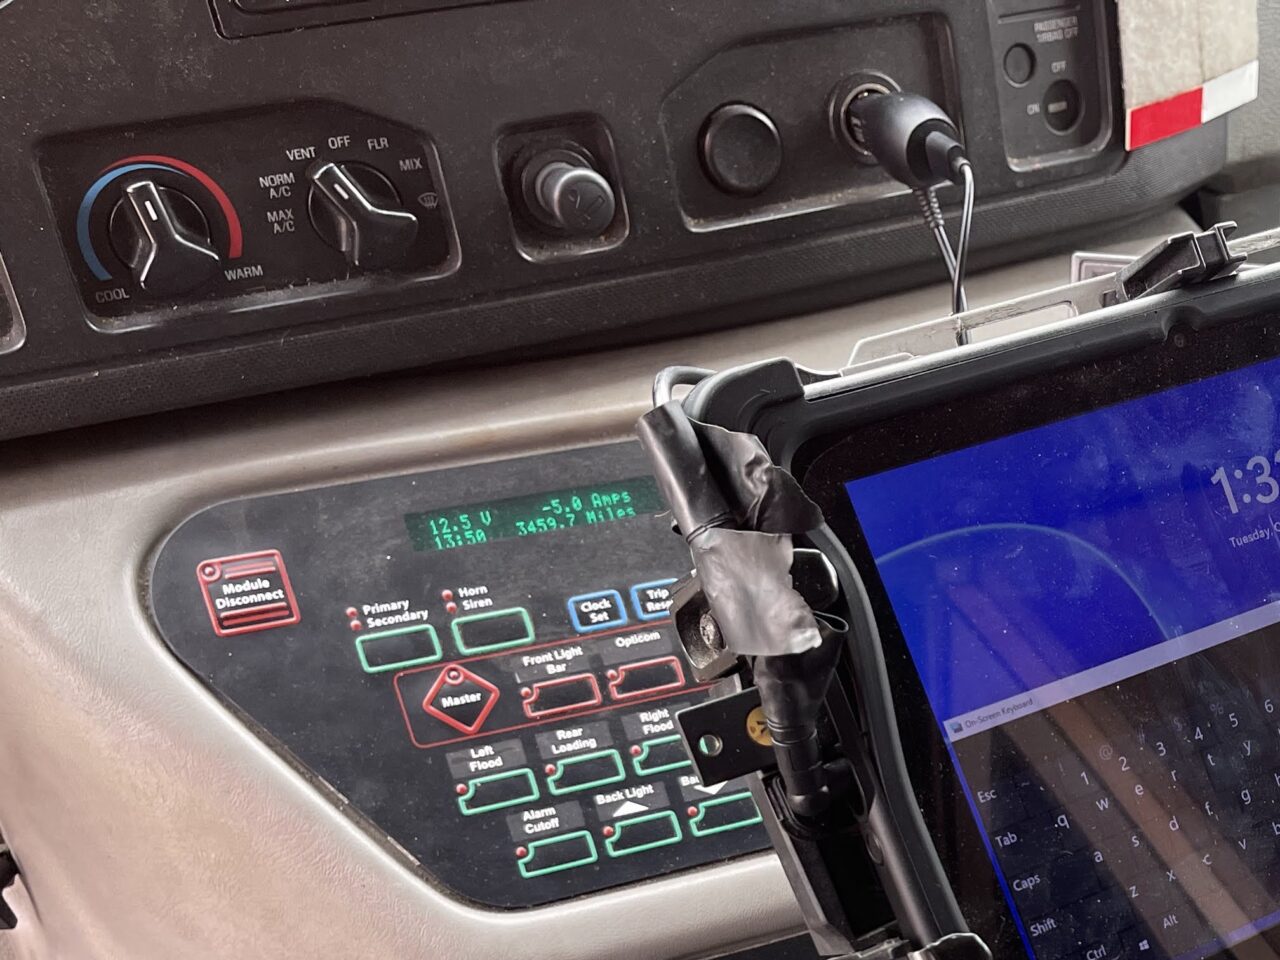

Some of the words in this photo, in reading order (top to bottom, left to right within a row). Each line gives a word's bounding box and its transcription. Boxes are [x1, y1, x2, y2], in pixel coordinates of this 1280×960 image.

[1051, 60, 1066, 73] OFF
[1026, 102, 1040, 115] ON
[327, 135, 350, 149] OFF
[367, 137, 389, 150] FLR
[286, 146, 317, 161] VENT
[399, 157, 423, 171] MIX
[259, 172, 295, 187] NORM
[269, 186, 291, 199] A/C
[267, 208, 294, 223] MAX
[273, 220, 295, 234] A/C
[224, 264, 264, 282] WARM
[95, 287, 130, 303] COOL
[429, 514, 472, 535] 12.5
[479, 510, 492, 527] V
[542, 496, 582, 514] -5.0
[591, 491, 632, 508] Amps
[434, 529, 487, 550] 13:50
[515, 513, 576, 536] 3459.7
[586, 505, 636, 525] Miles
[1228, 526, 1274, 548] Tuesday,
[222, 578, 270, 595] Module
[458, 585, 488, 598] Horn
[646, 587, 670, 600] Trip
[215, 589, 285, 609] Disconnect
[462, 598, 493, 610] Siren
[580, 598, 612, 613] Clock
[362, 600, 409, 616] Primary
[366, 609, 429, 628] Secondary
[589, 611, 609, 624] Set
[615, 630, 661, 648] Opticom
[522, 653, 553, 667] Front
[553, 645, 584, 662] Light
[546, 662, 567, 675] Bar
[441, 692, 482, 708] Master
[639, 708, 670, 723] Right
[556, 727, 584, 741] Rear
[642, 720, 675, 735] Flood
[470, 744, 494, 759] Left
[552, 737, 597, 755] Loading
[977, 789, 998, 803] Esc
[1080, 771, 1090, 785] 1
[1119, 756, 1130, 771] 2
[1156, 741, 1167, 756] 3
[1194, 726, 1204, 741] 4
[1229, 712, 1239, 728] 5
[1264, 699, 1274, 714] 6
[469, 756, 504, 772] Flood
[595, 791, 625, 805] Back
[624, 784, 655, 799] Light
[995, 832, 1018, 848] Tab
[1057, 814, 1070, 829] q
[1095, 798, 1109, 811] w
[1134, 784, 1144, 795] e
[1171, 769, 1177, 782] r
[1207, 753, 1216, 766] t
[1243, 740, 1251, 756] y
[523, 806, 556, 821] Alarm
[524, 817, 560, 834] Cutoff
[1012, 874, 1041, 892] Caps
[1093, 851, 1104, 863] a
[1131, 835, 1140, 848] s
[1169, 815, 1179, 831] d
[1204, 801, 1213, 816] f
[1241, 788, 1251, 805] g
[1029, 917, 1058, 937] Shift
[1129, 885, 1138, 898] z
[1166, 869, 1176, 882] x
[1202, 854, 1212, 865] c
[1238, 838, 1247, 850] v
[1163, 914, 1178, 929] Alt
